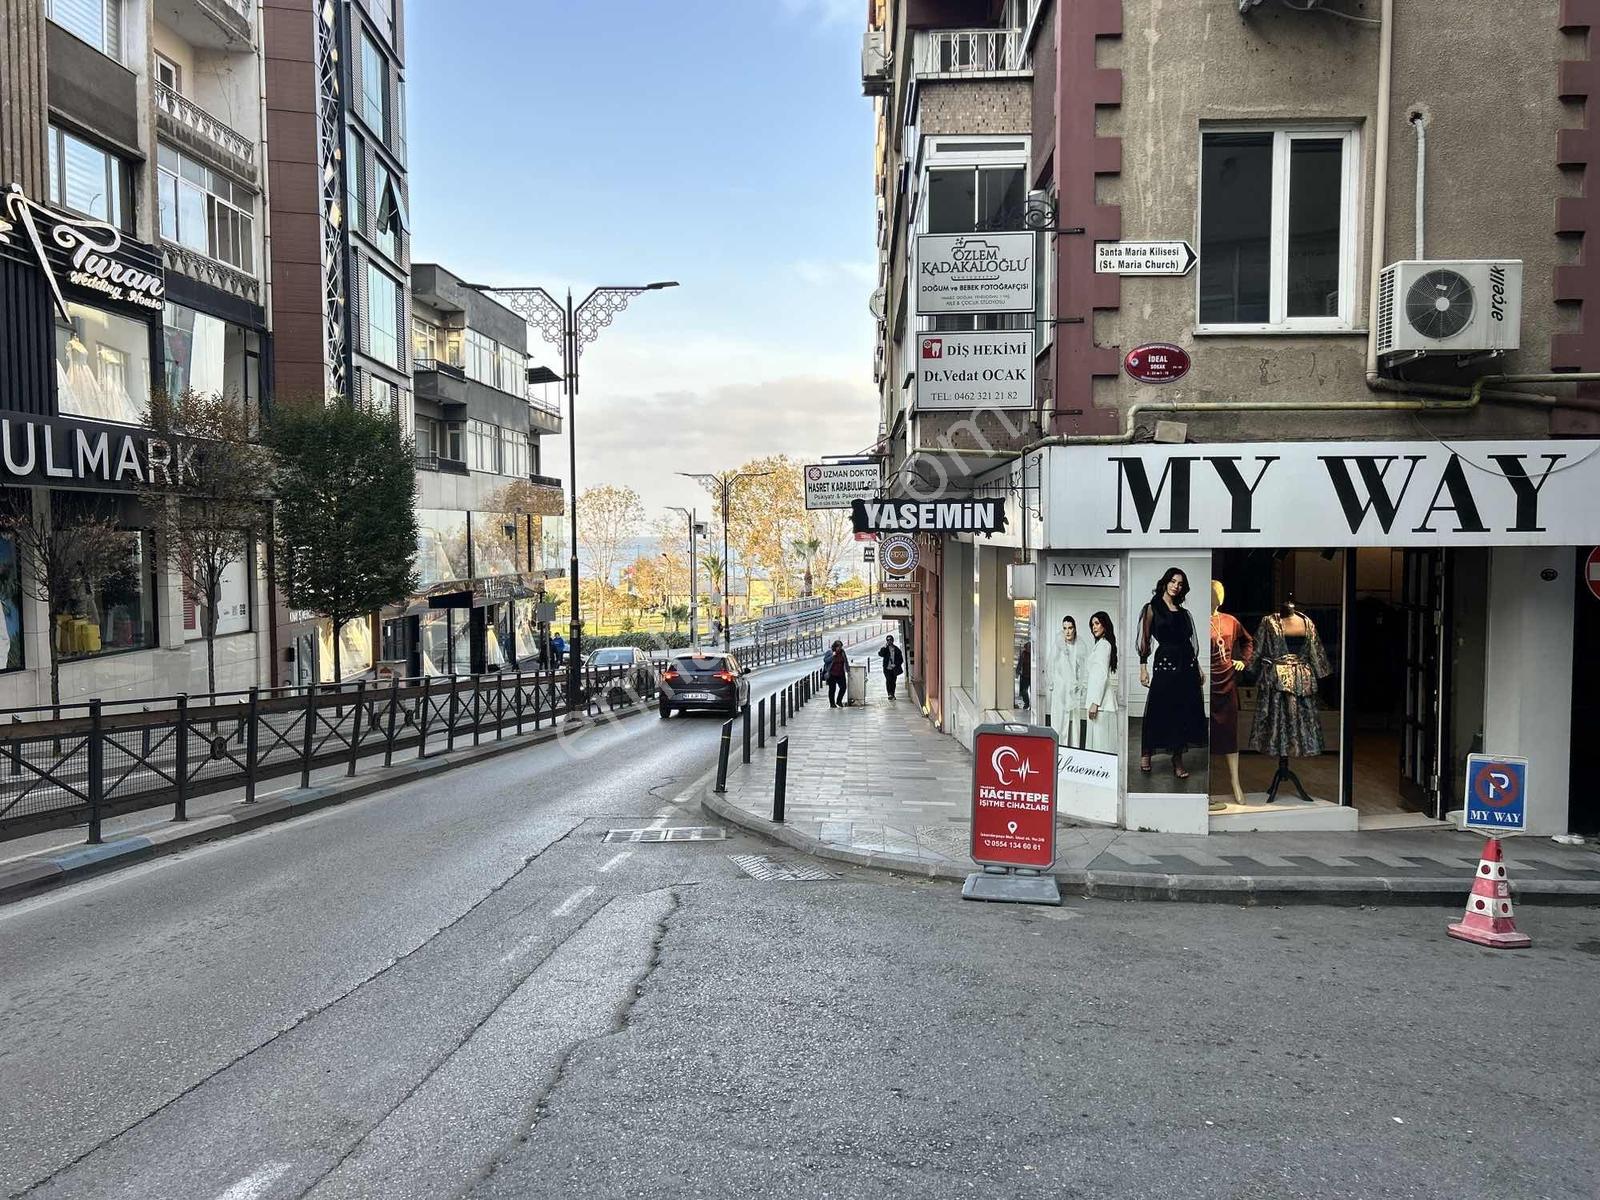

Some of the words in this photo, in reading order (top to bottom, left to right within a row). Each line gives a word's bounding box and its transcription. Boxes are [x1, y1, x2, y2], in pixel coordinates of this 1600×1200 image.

[53, 214, 164, 296] Turan
[953, 249, 998, 261] ÖZLEM
[1100, 248, 1122, 256] Santa
[1125, 247, 1147, 256] Maria
[1149, 247, 1179, 256] Kilisesi
[921, 257, 1030, 276] KADAKALOĞLU
[1100, 261, 1115, 270] (St.
[1118, 260, 1142, 269] Maria
[1145, 260, 1179, 270] Church)
[69, 270, 122, 299] Wedding
[127, 289, 163, 310] House
[922, 284, 949, 292] DOĞUM
[981, 282, 1029, 291] FOTOĞRAFÇISI
[1490, 264, 1507, 321] arçelik
[947, 343, 970, 357] DİŞ
[973, 342, 1027, 355] HEKİMİ
[924, 370, 978, 382] Dt.Vedat
[982, 369, 1027, 380] OCAK
[930, 393, 951, 401] TEL:
[954, 392, 975, 400] 0462
[978, 392, 992, 400] 321
[823, 470, 848, 478] UZMAN
[849, 469, 878, 477] DOKTOR
[808, 482, 829, 492] HASRET
[1106, 455, 1281, 533] MY
[1317, 453, 1566, 534] WAY
[1053, 563, 1077, 576] MY
[1081, 564, 1116, 577] WAY
[980, 788, 1049, 804] HACETTEPE
[1470, 810, 1489, 821] MY
[1494, 811, 1520, 823] WAY
